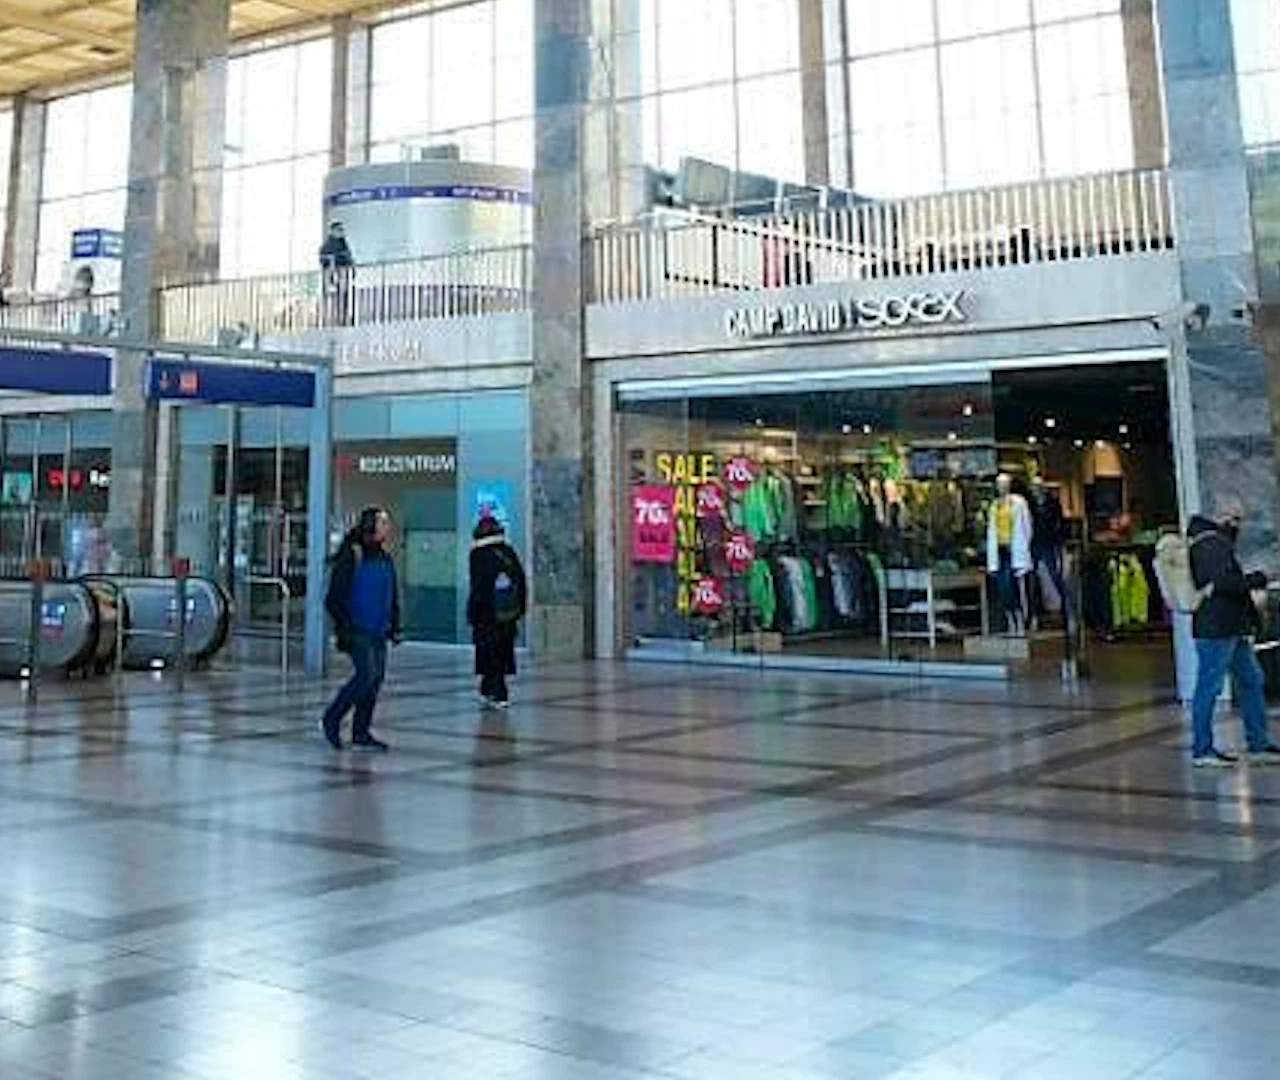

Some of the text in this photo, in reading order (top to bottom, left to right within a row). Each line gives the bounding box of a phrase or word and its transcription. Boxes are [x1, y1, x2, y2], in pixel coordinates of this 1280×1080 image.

[726, 306, 781, 337] CAMP
[783, 300, 840, 333] DAVID
[656, 453, 714, 484] SALE
